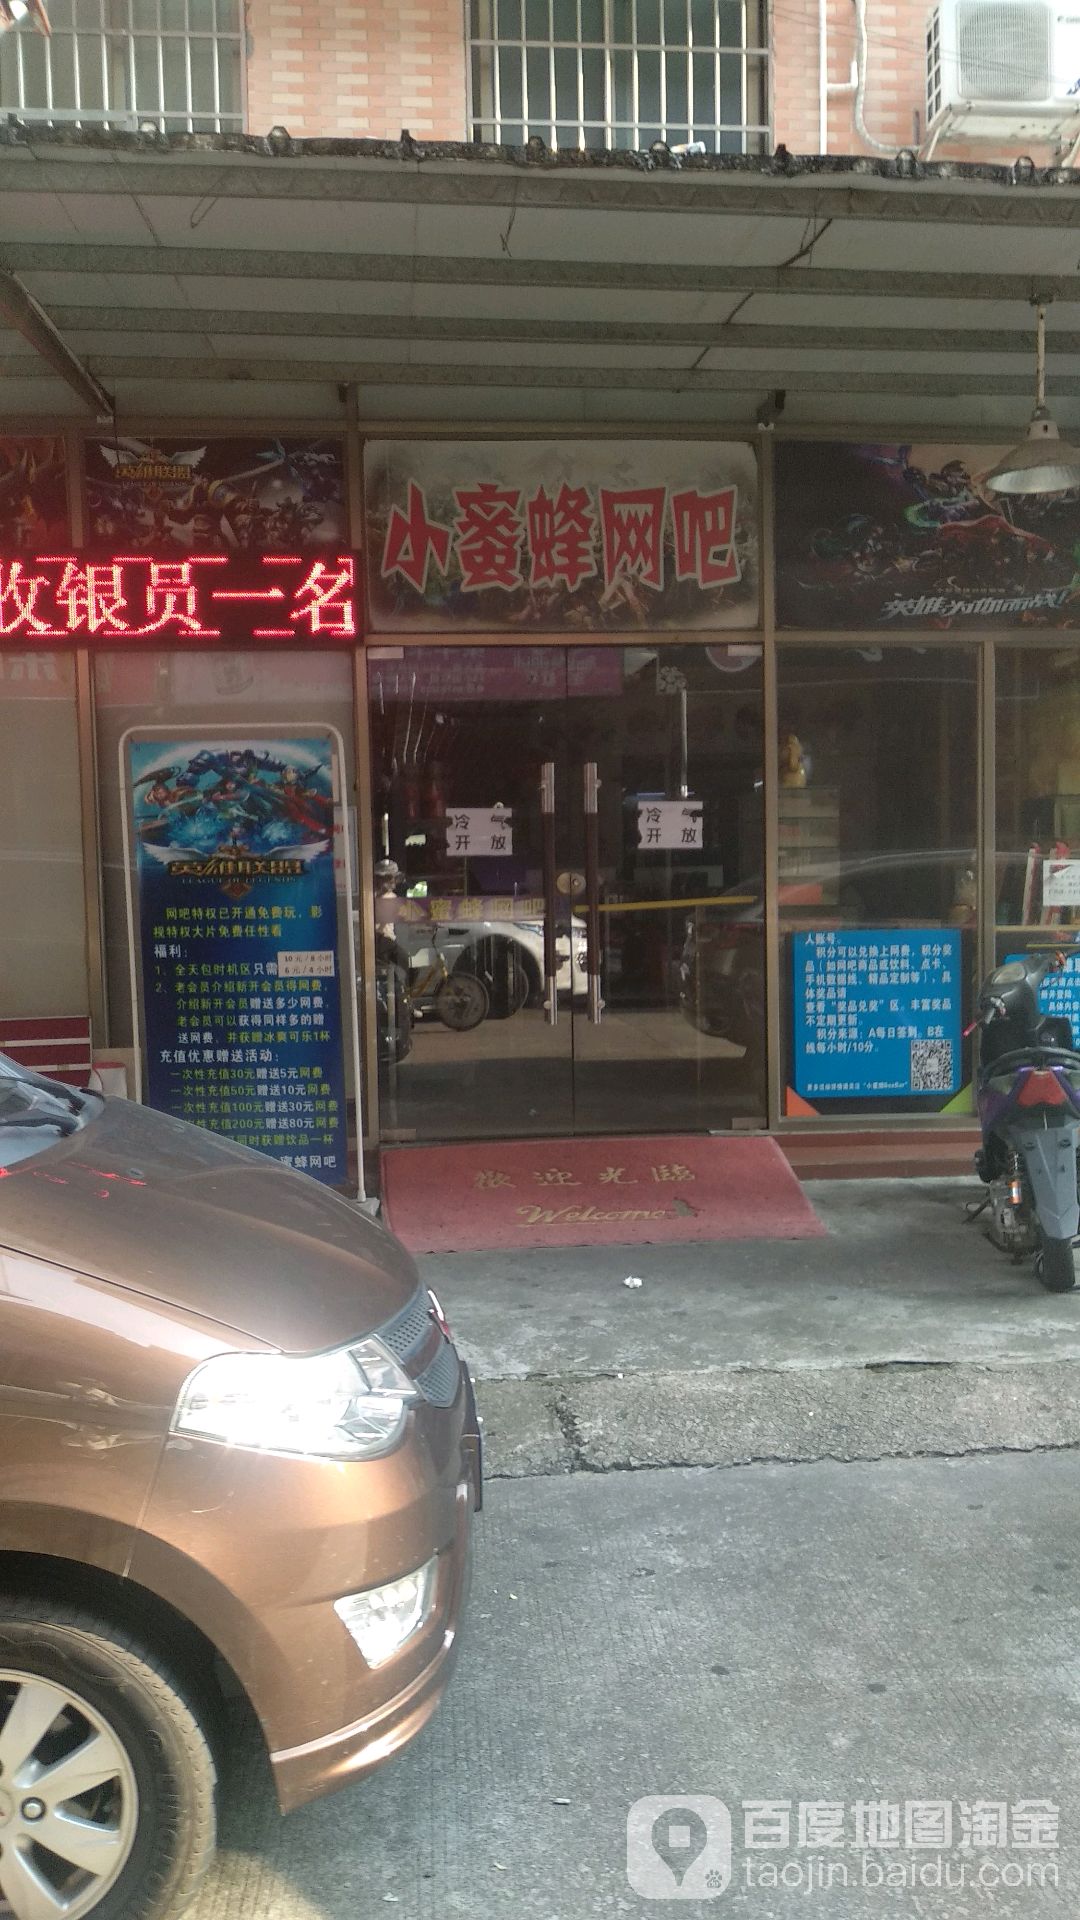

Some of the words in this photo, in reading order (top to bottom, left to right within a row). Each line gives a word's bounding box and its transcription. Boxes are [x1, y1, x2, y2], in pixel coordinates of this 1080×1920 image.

[381, 477, 742, 594] 小蜜蜂网吧
[0, 560, 354, 634] 收银员一名
[455, 834, 507, 850] 开放
[647, 827, 697, 843] 开放
[176, 1014, 325, 1027] 老会员可以获得同样多的赠
[171, 1067, 323, 1080] 一次性充值30元赠送5元网费
[171, 1084, 331, 1097] 一次性充值50元赠送10元网费
[172, 1100, 338, 1114] 一次性充值100元赠送30元网费
[515, 1204, 667, 1228] Welcome
